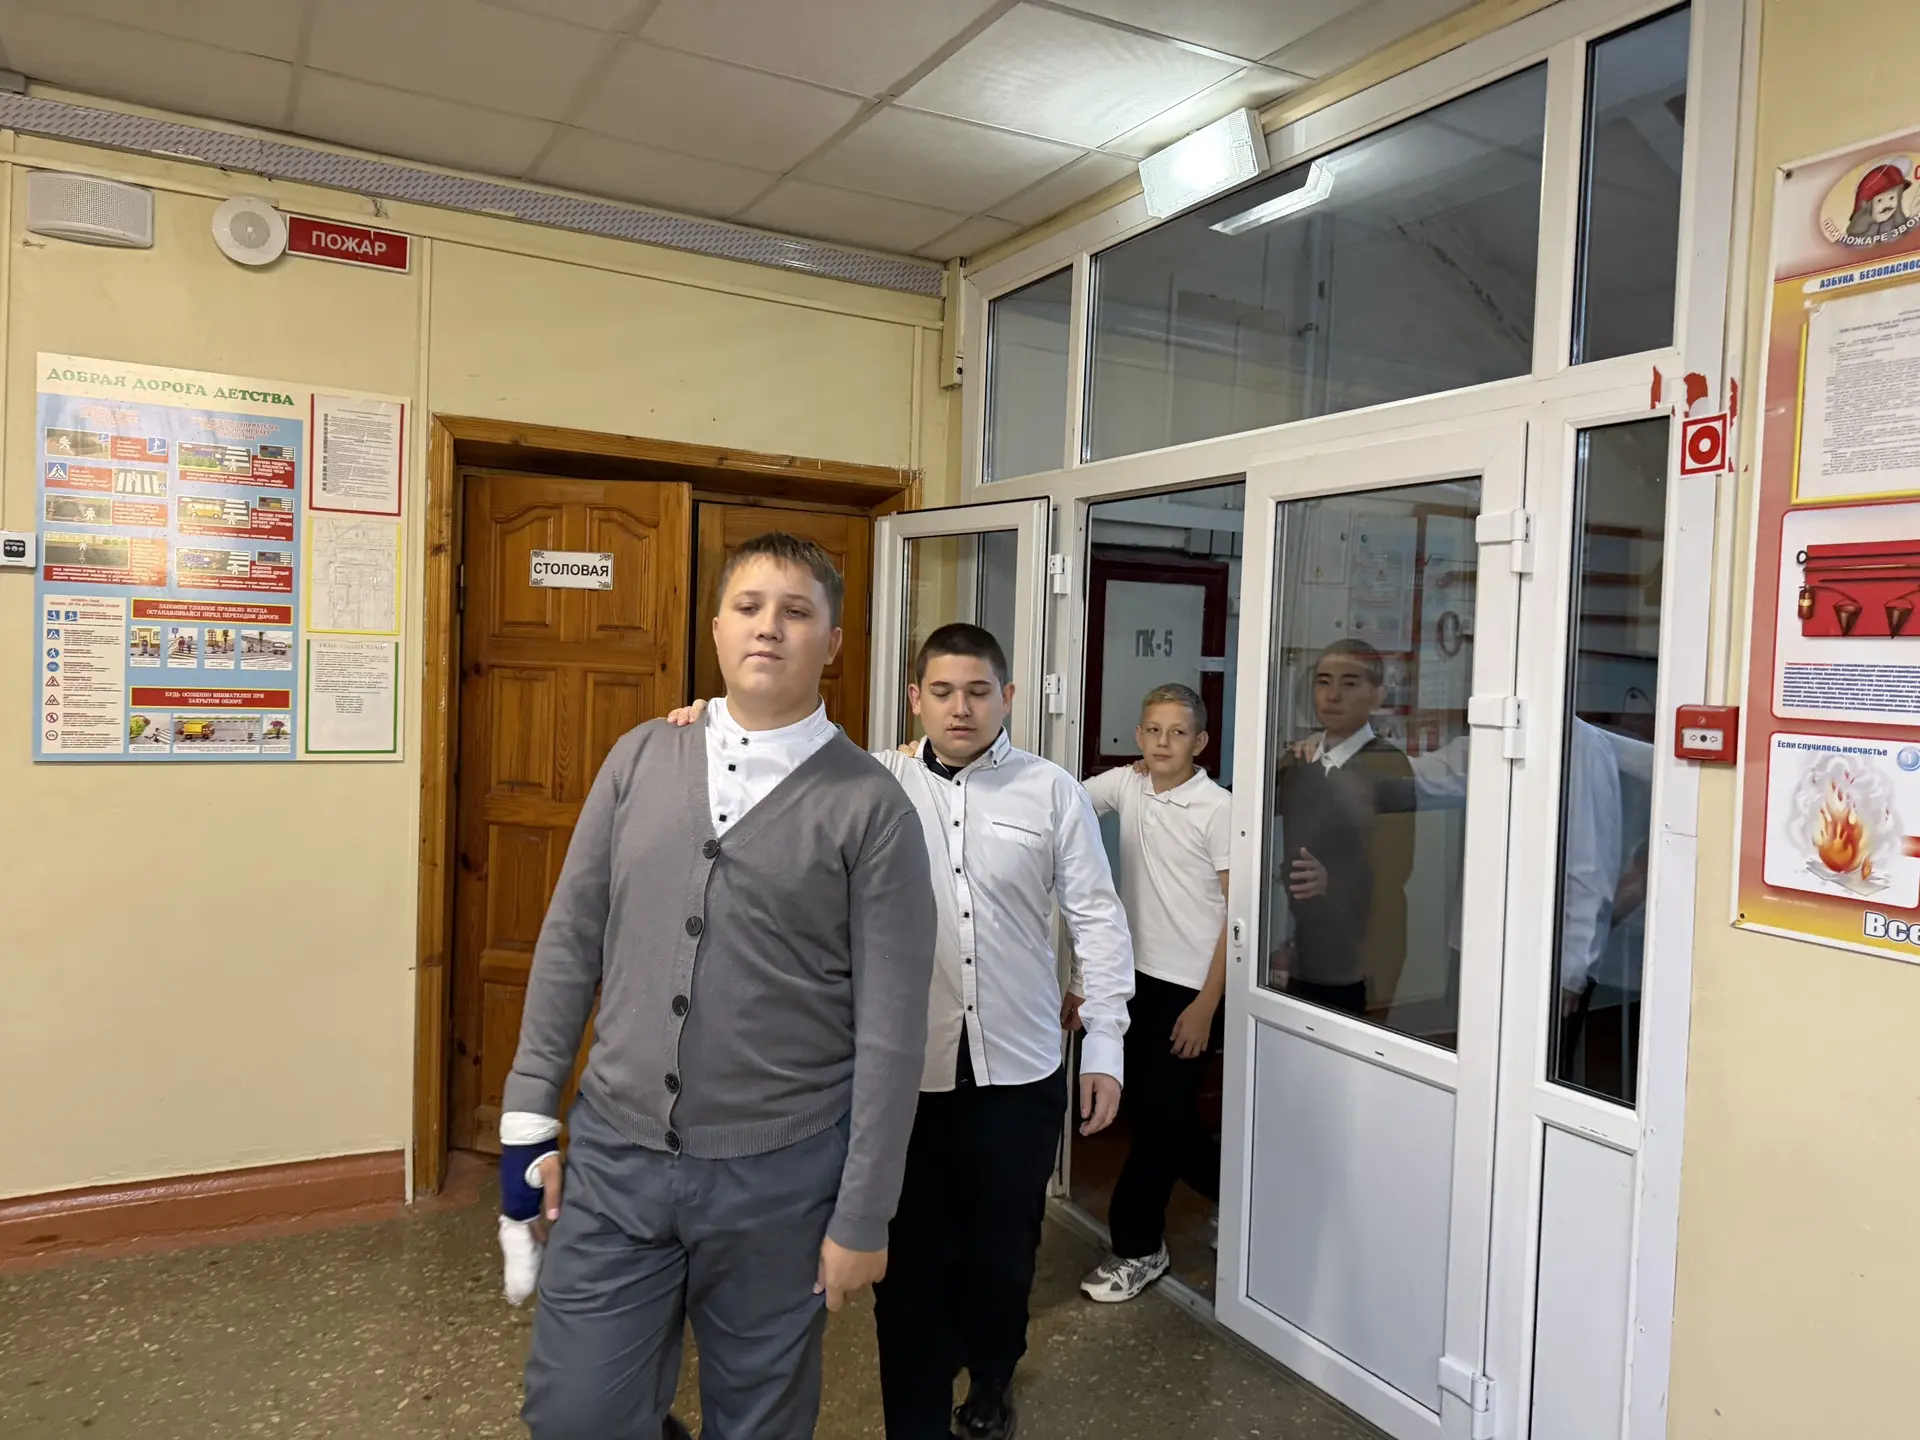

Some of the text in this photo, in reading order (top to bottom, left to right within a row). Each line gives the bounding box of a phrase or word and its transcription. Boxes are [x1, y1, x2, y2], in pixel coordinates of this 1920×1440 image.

[312, 230, 387, 256] ПОЖАР
[1838, 233, 1888, 245] ПОЖАРЕ
[1819, 274, 1854, 289] АЗБУКА
[47, 368, 295, 406] ДОБРАЯ ДОРОГА ДЕТСТВА
[533, 562, 609, 577] СТОЛОВАЯ
[1135, 629, 1173, 657] ПК-5
[1777, 740, 1888, 756] Если случилось несчастье
